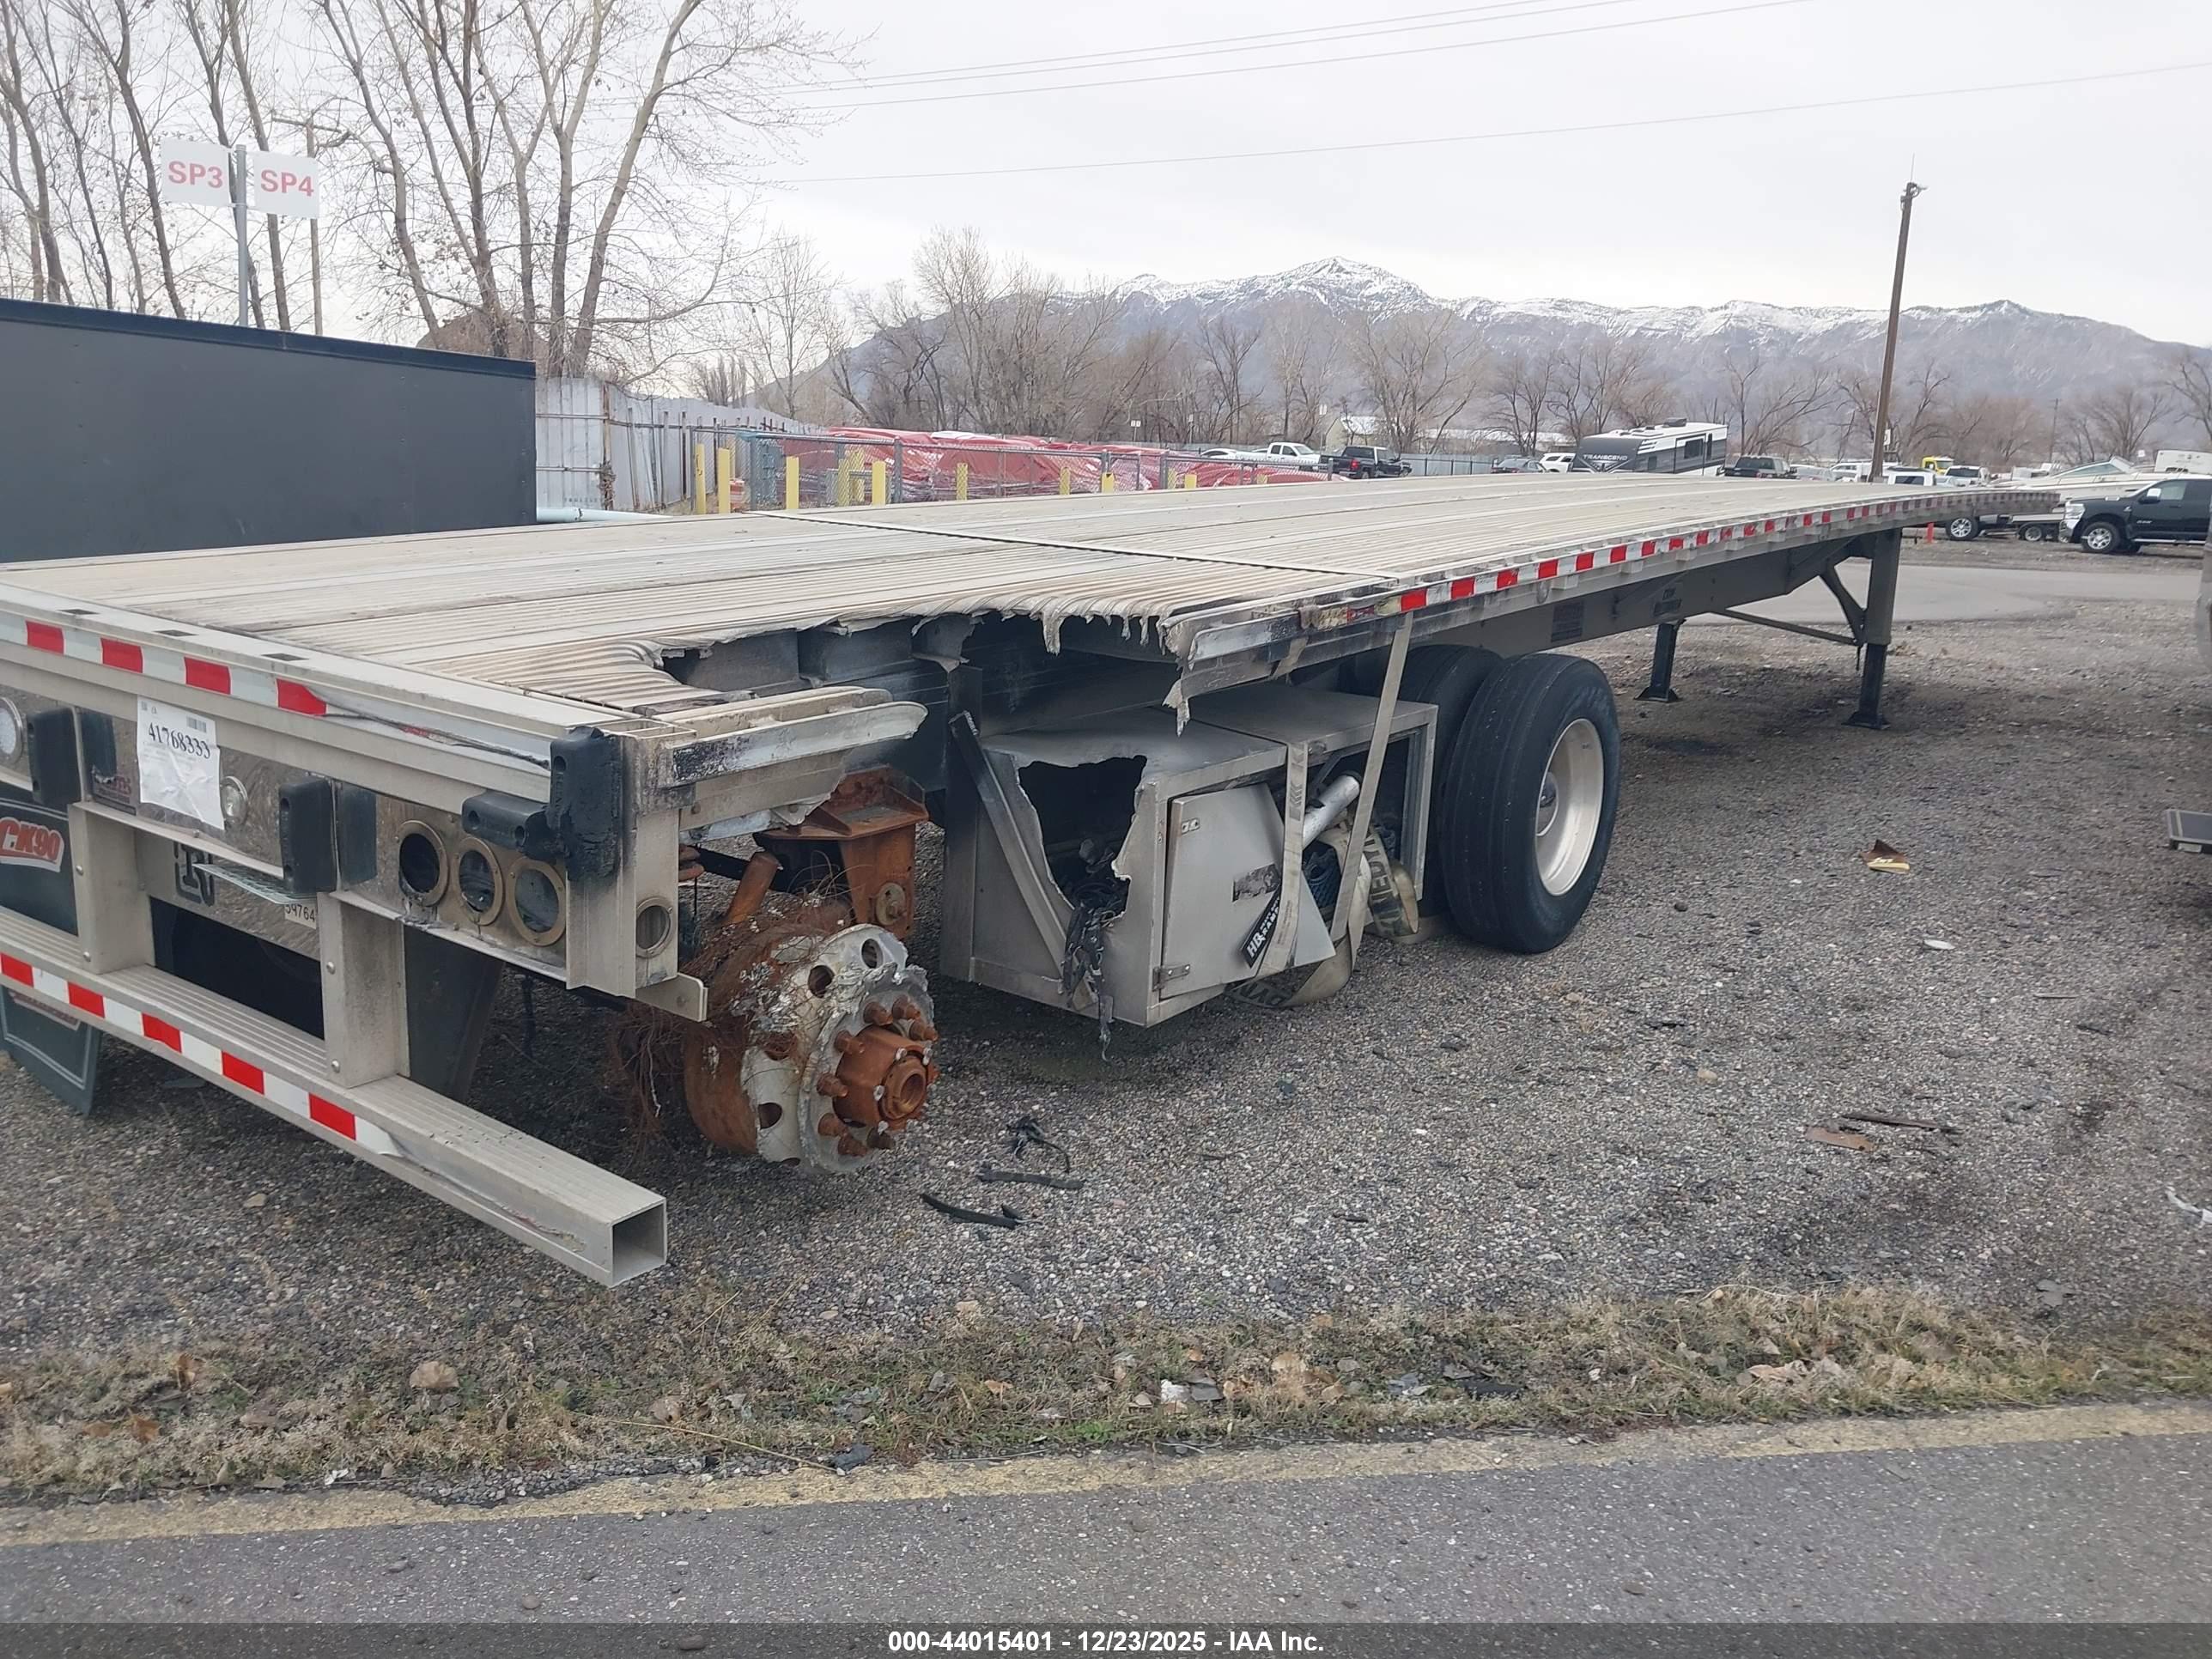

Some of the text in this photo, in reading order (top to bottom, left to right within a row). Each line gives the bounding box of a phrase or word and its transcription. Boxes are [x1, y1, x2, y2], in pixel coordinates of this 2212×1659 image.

[168, 161, 223, 189] SP3
[260, 169, 314, 197] SP4
[149, 721, 211, 760] 41768333
